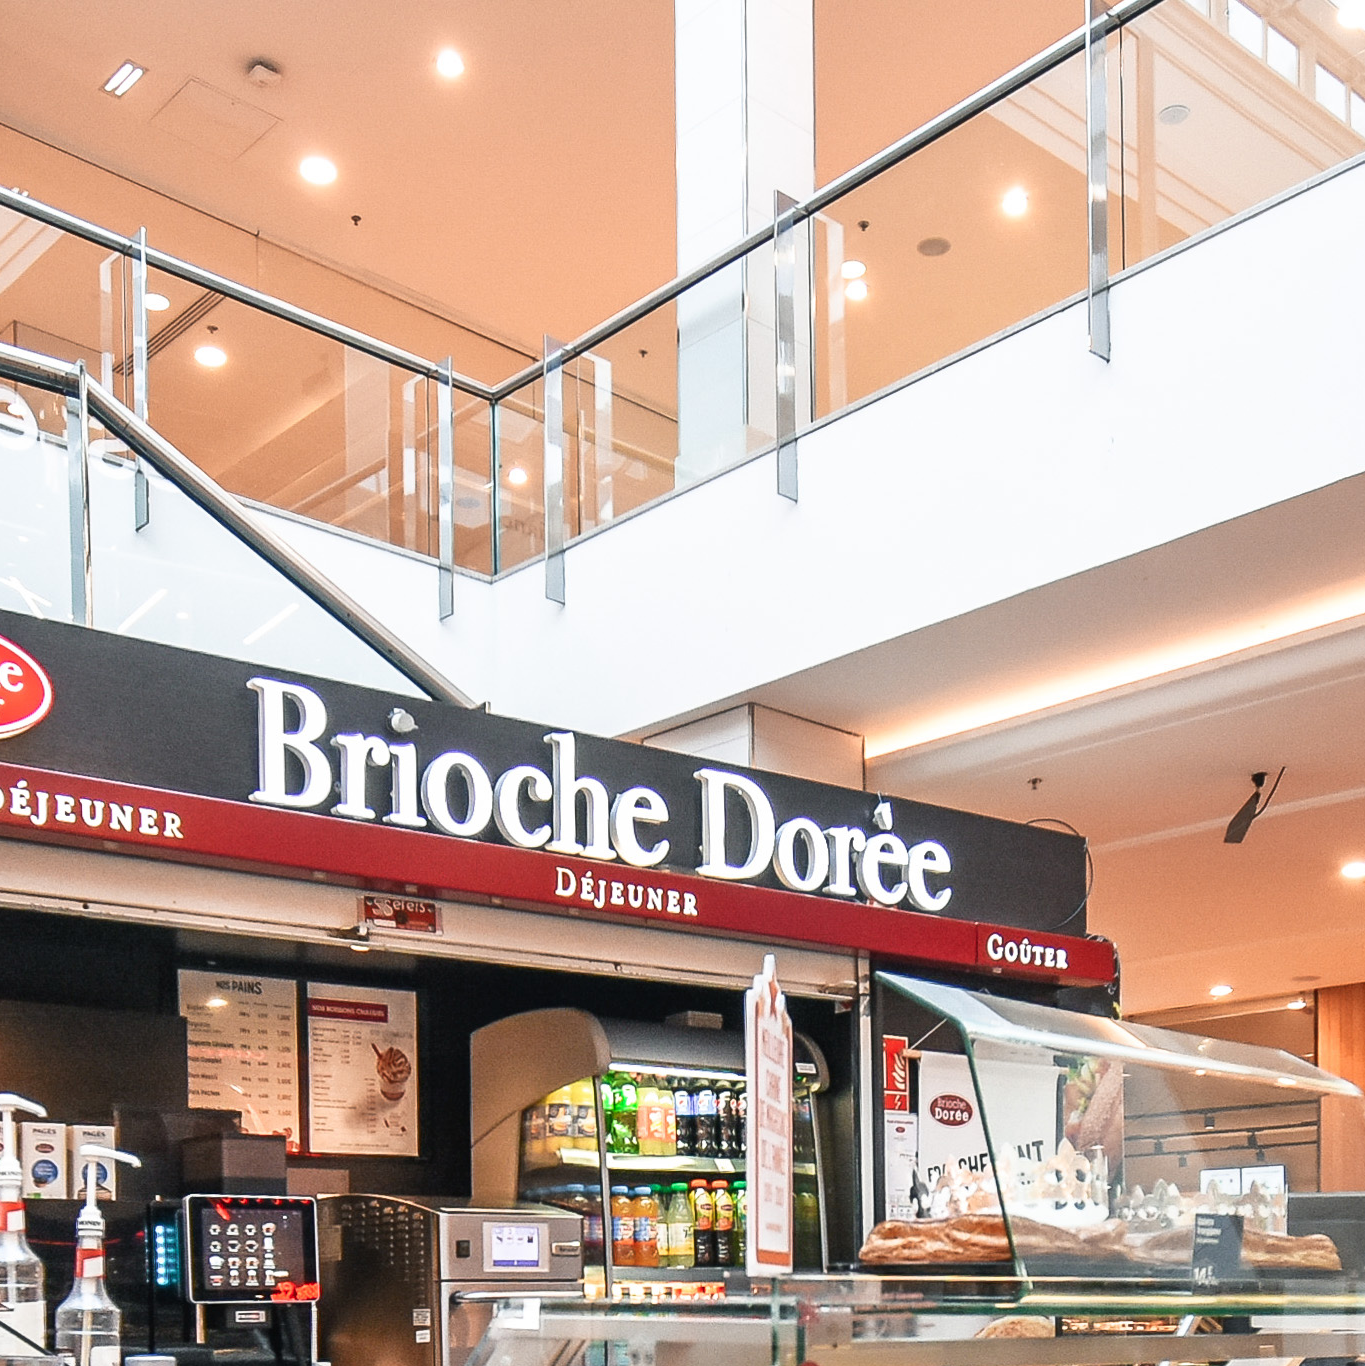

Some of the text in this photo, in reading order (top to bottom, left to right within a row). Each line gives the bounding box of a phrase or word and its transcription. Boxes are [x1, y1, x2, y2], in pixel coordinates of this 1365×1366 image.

[247, 676, 953, 912] Brioche Dorée
[555, 866, 699, 917] DÉJEUNER
[987, 932, 1069, 970] GOÛTER
[231, 981, 263, 995] PAINS
[935, 1107, 969, 1122] Dorée
[936, 1097, 967, 1109] Brioche
